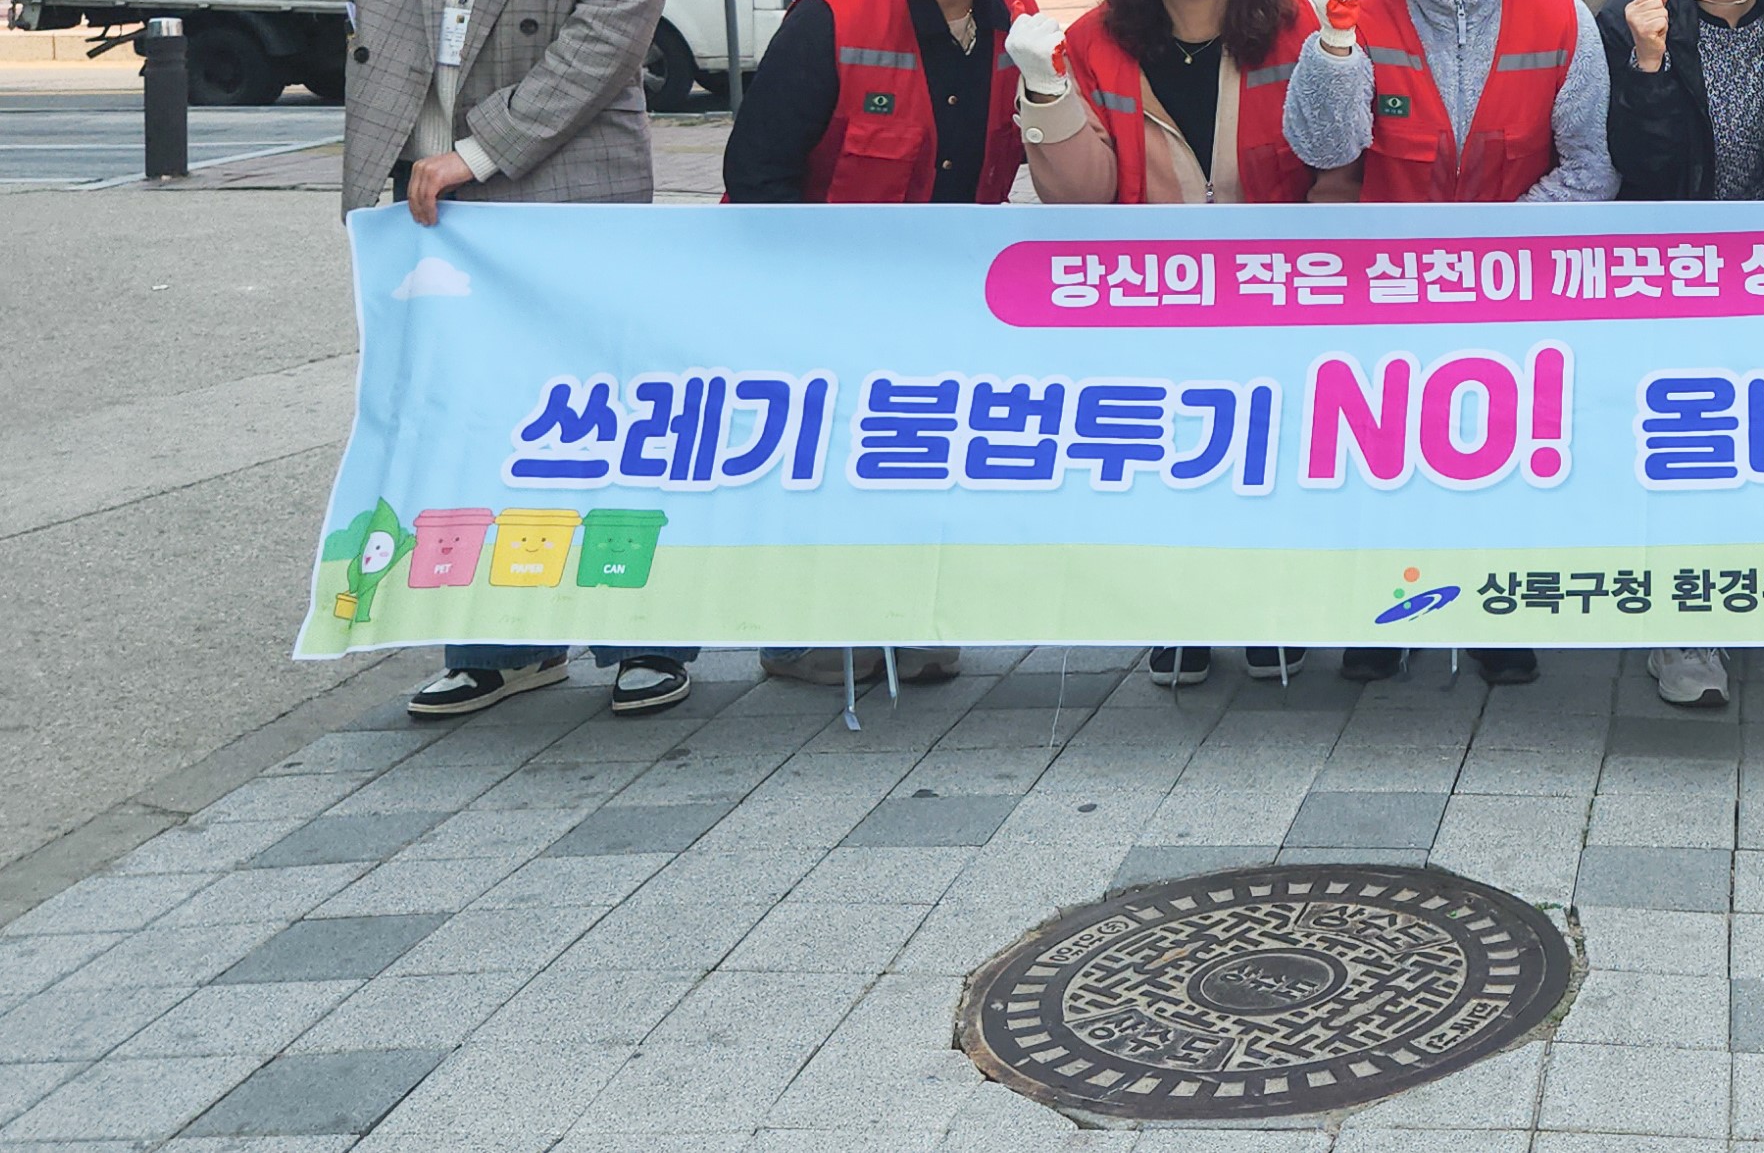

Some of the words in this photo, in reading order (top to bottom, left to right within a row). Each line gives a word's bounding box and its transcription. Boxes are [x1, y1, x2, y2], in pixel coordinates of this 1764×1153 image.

[1050, 252, 1216, 308] 당신의
[1234, 251, 1349, 306] 작은
[1365, 247, 1534, 304] 실천이
[1550, 242, 1725, 300] 깨끗한
[509, 375, 830, 483] 쓰레기
[854, 377, 1274, 487] 불법투기
[1306, 346, 1567, 481] NO!
[433, 563, 453, 574] PET
[603, 564, 626, 574] CAN
[1476, 568, 1653, 615] 상록구청
[1312, 904, 1440, 951] 상수도
[1088, 1014, 1222, 1064] 상수도
